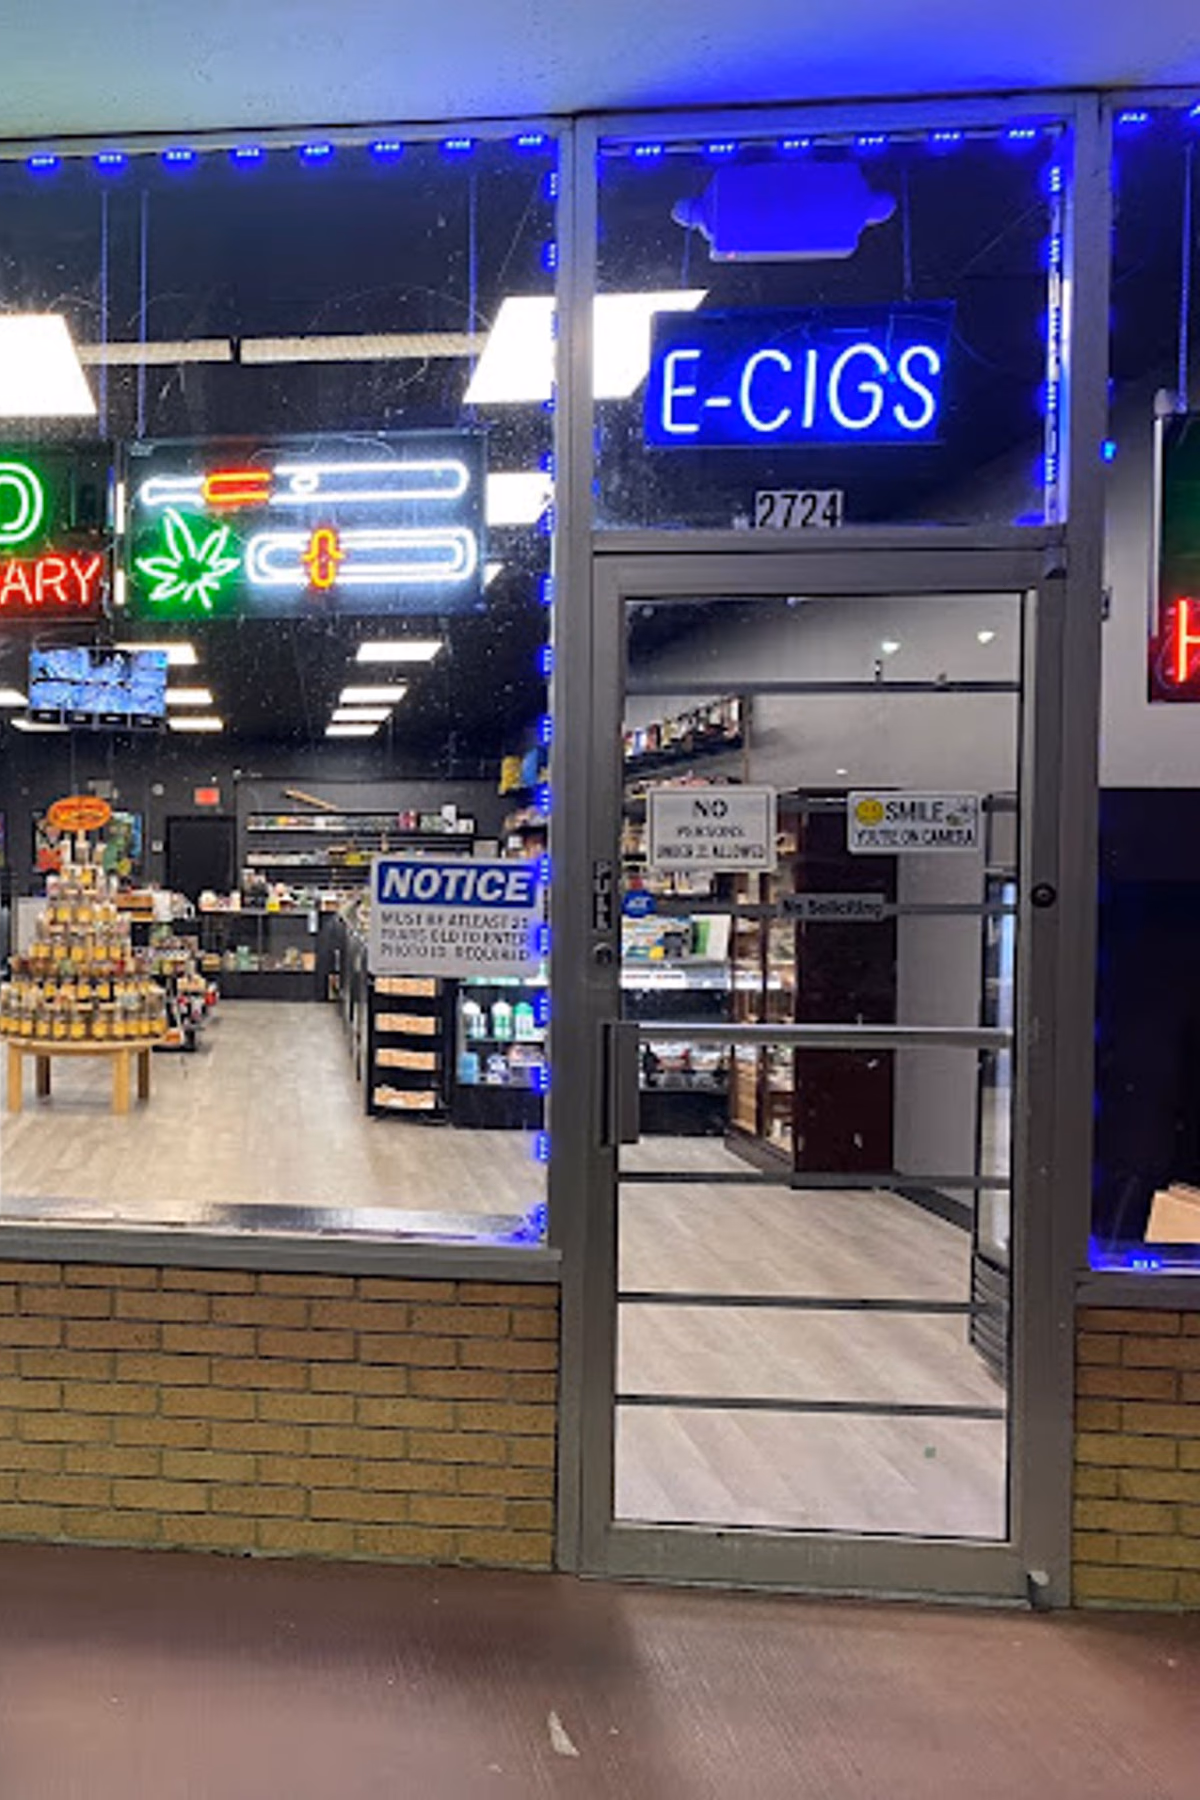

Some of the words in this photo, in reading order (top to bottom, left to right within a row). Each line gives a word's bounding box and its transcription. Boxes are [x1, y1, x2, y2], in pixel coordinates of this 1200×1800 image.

[661, 343, 941, 433] E-CIGS
[757, 493, 841, 527] 2724
[693, 799, 728, 819] NO
[885, 801, 945, 823] SMILE
[901, 829, 918, 845] ON
[922, 829, 974, 845] CAMERA
[381, 866, 534, 902] NOTICE
[596, 860, 609, 930] PULL
[782, 899, 802, 915] No
[380, 911, 422, 926] MUST
[430, 929, 459, 944] OLD
